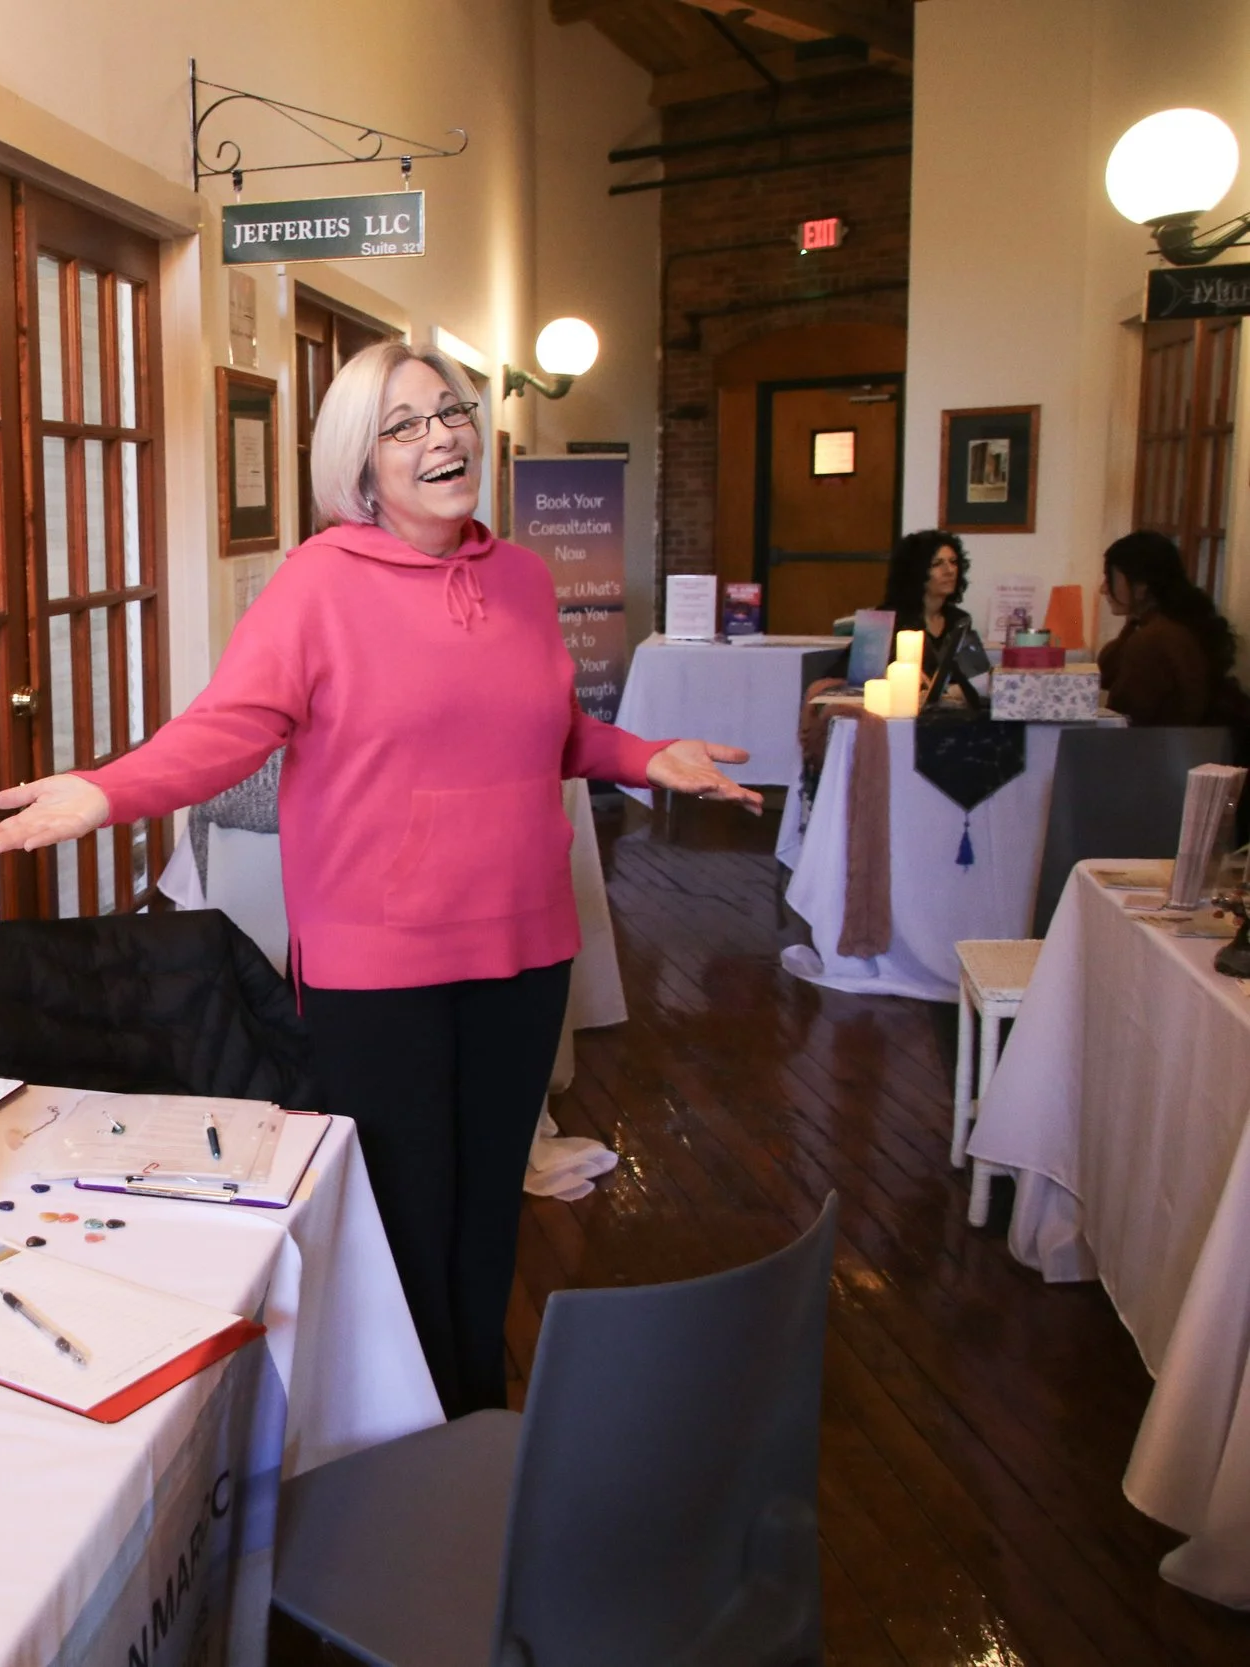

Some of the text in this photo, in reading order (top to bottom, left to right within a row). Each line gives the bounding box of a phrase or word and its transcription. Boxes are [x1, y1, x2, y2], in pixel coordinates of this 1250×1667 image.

[232, 214, 410, 249] JEFFERIES LLC
[804, 218, 838, 249] EXIT
[361, 242, 423, 256] Suite 321
[536, 493, 604, 511] Book Your
[529, 519, 612, 537] Consultation
[555, 546, 586, 561] Now
[574, 581, 621, 599] What's
[584, 607, 608, 623] You
[582, 632, 596, 648] to
[580, 657, 610, 673] Your
